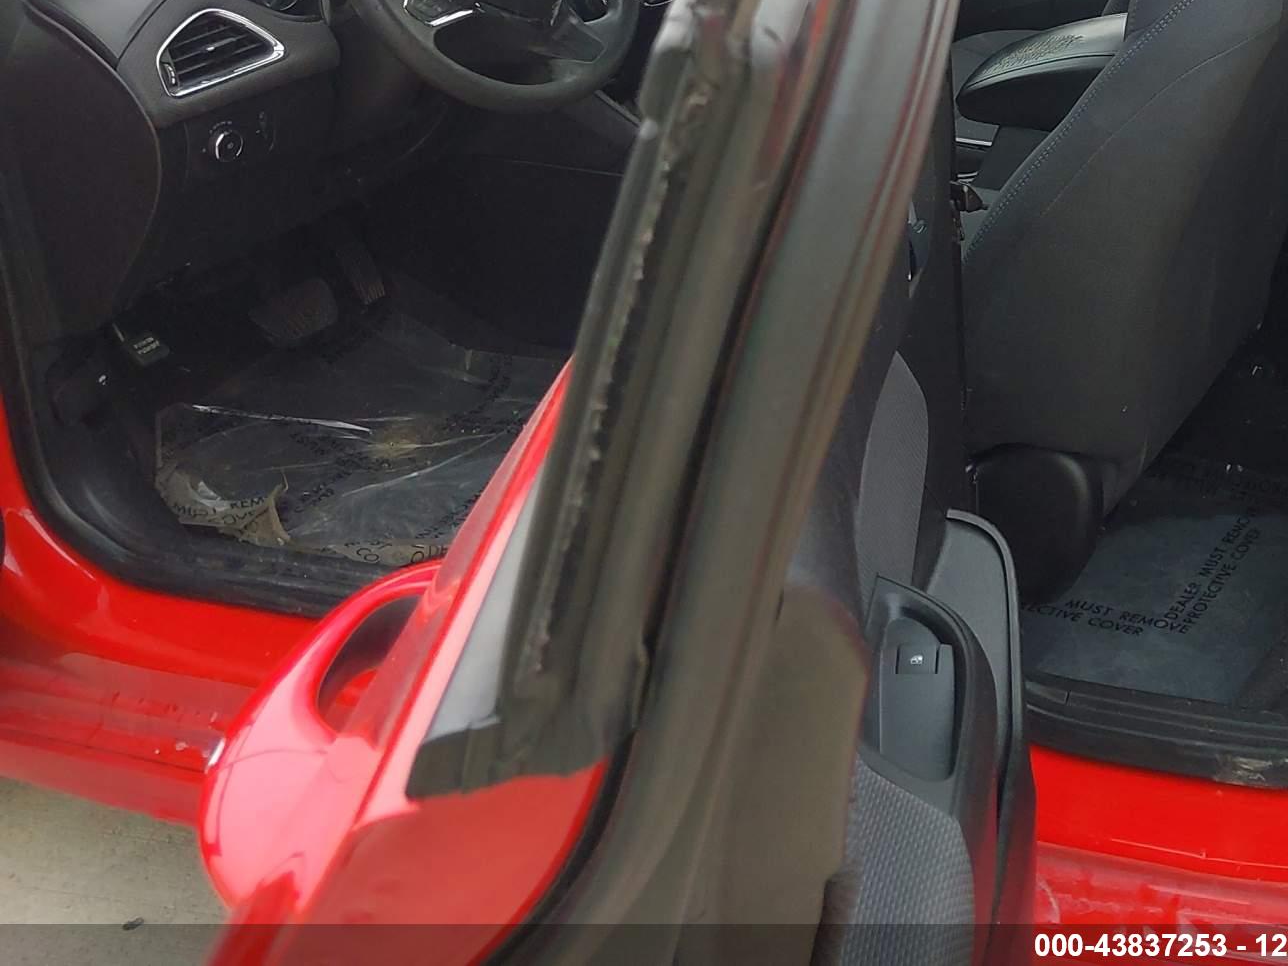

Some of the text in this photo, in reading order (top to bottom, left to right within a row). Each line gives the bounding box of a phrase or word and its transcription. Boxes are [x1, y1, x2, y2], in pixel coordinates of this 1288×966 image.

[1198, 545, 1228, 578] MUST
[1182, 562, 1238, 626] PROTECTIVE
[1064, 599, 1190, 635] MUST REMOVE
[1087, 617, 1145, 636] COVER
